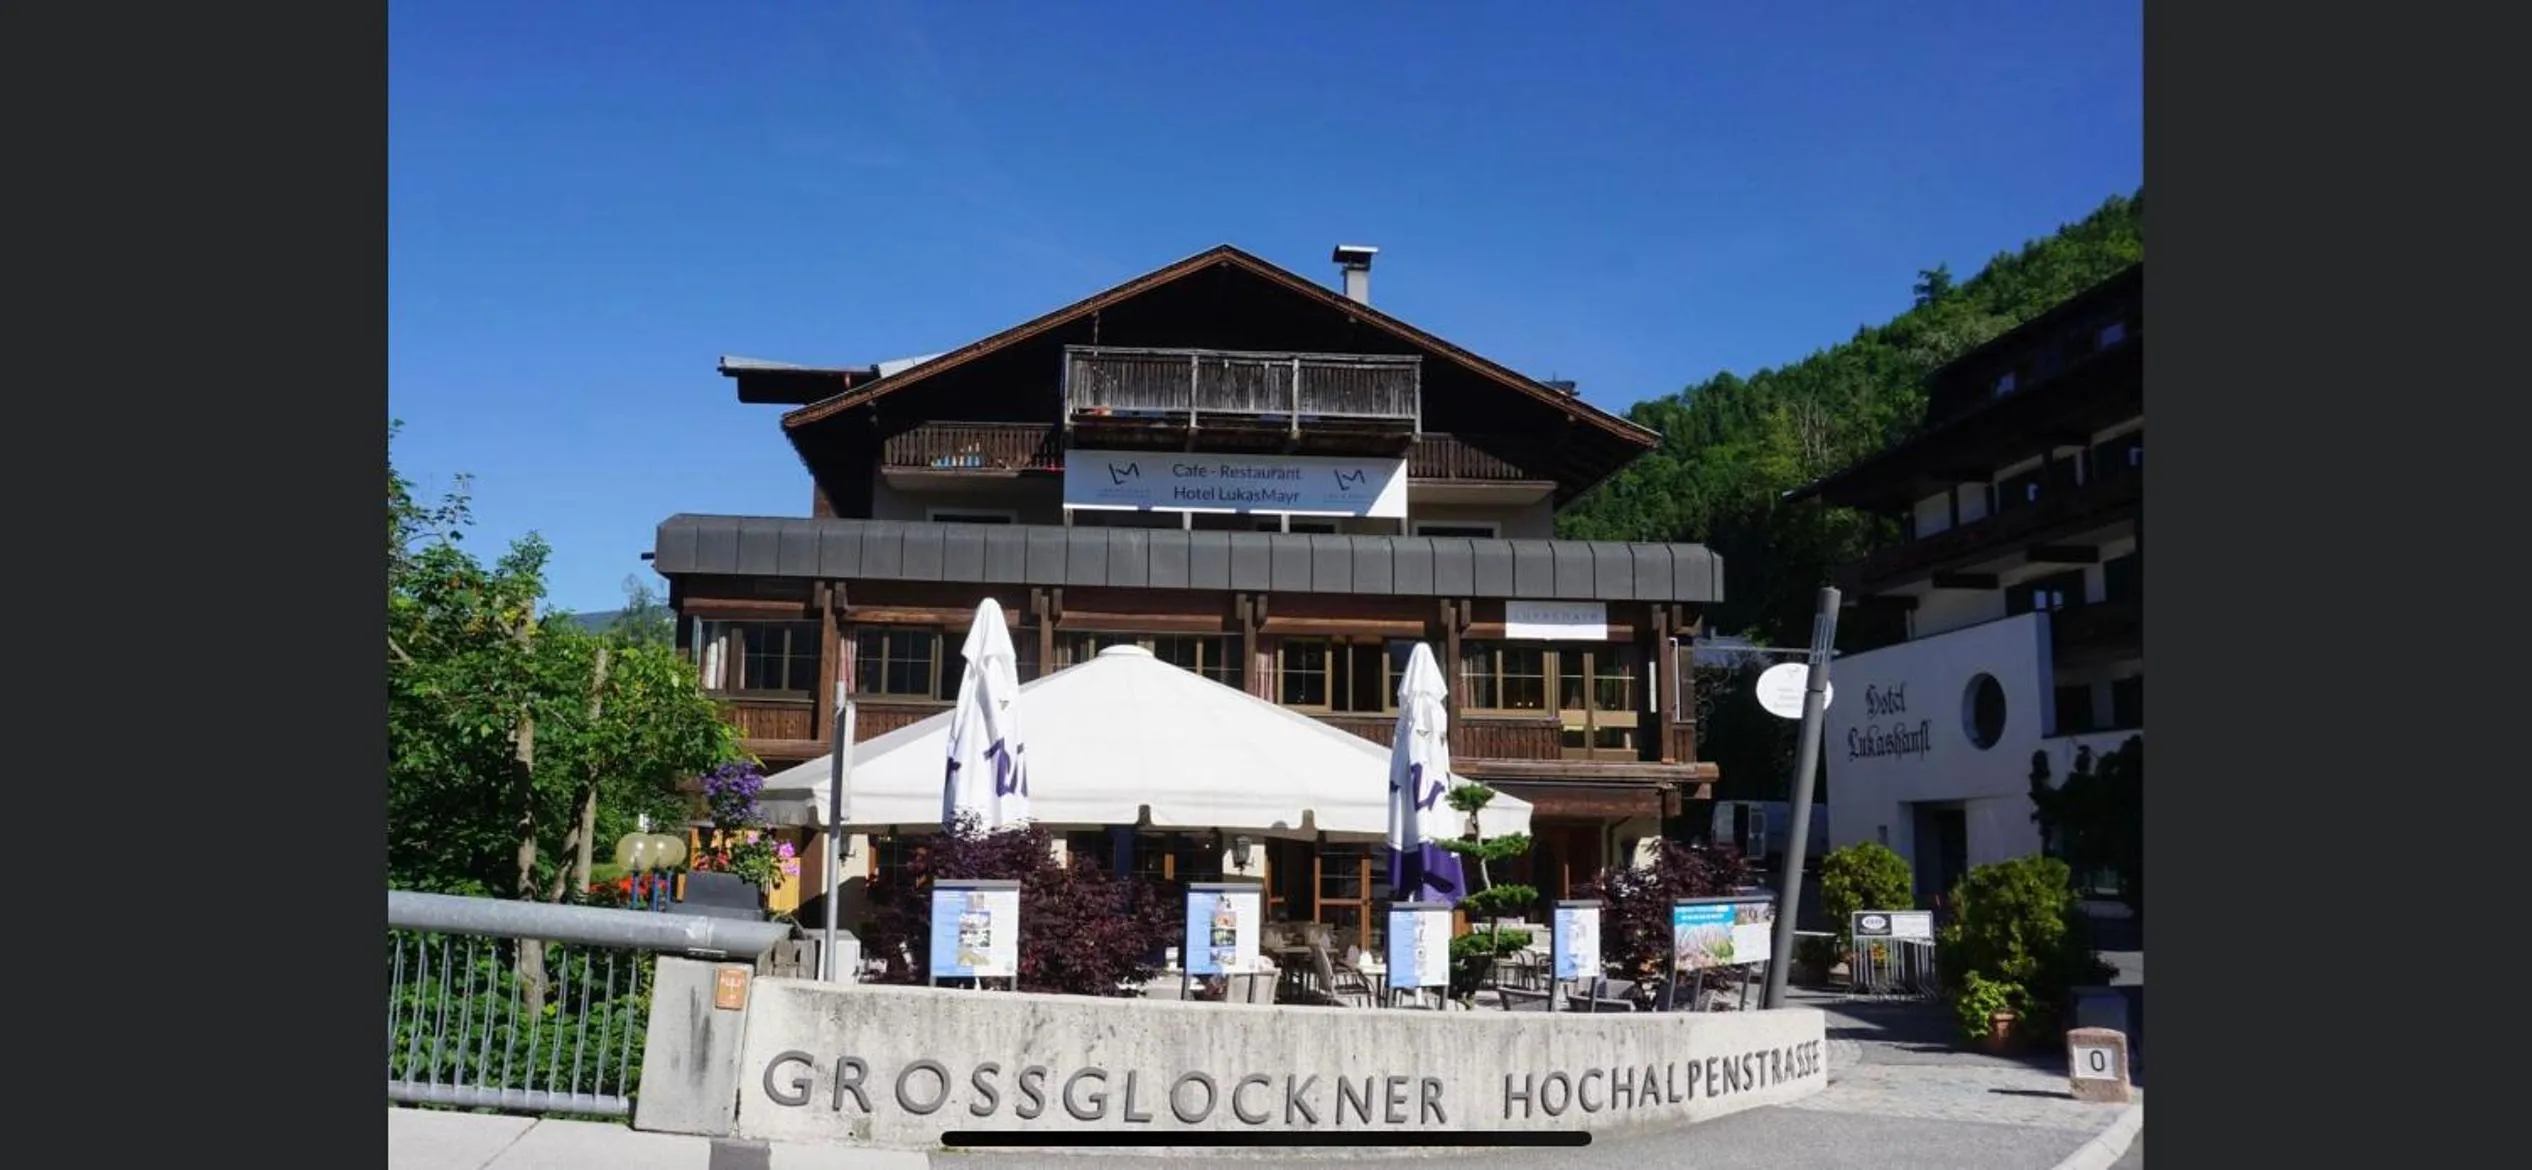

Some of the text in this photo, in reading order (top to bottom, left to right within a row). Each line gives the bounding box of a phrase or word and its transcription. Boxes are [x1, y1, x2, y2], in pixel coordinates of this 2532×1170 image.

[1220, 464, 1302, 481] Restaurant
[1173, 485, 1300, 505] Hotel LukasMayr
[1864, 681, 1908, 720] Hotel
[763, 1038, 1822, 1126] GROSSGLOCKNER HOCHALPENSTRASSE
